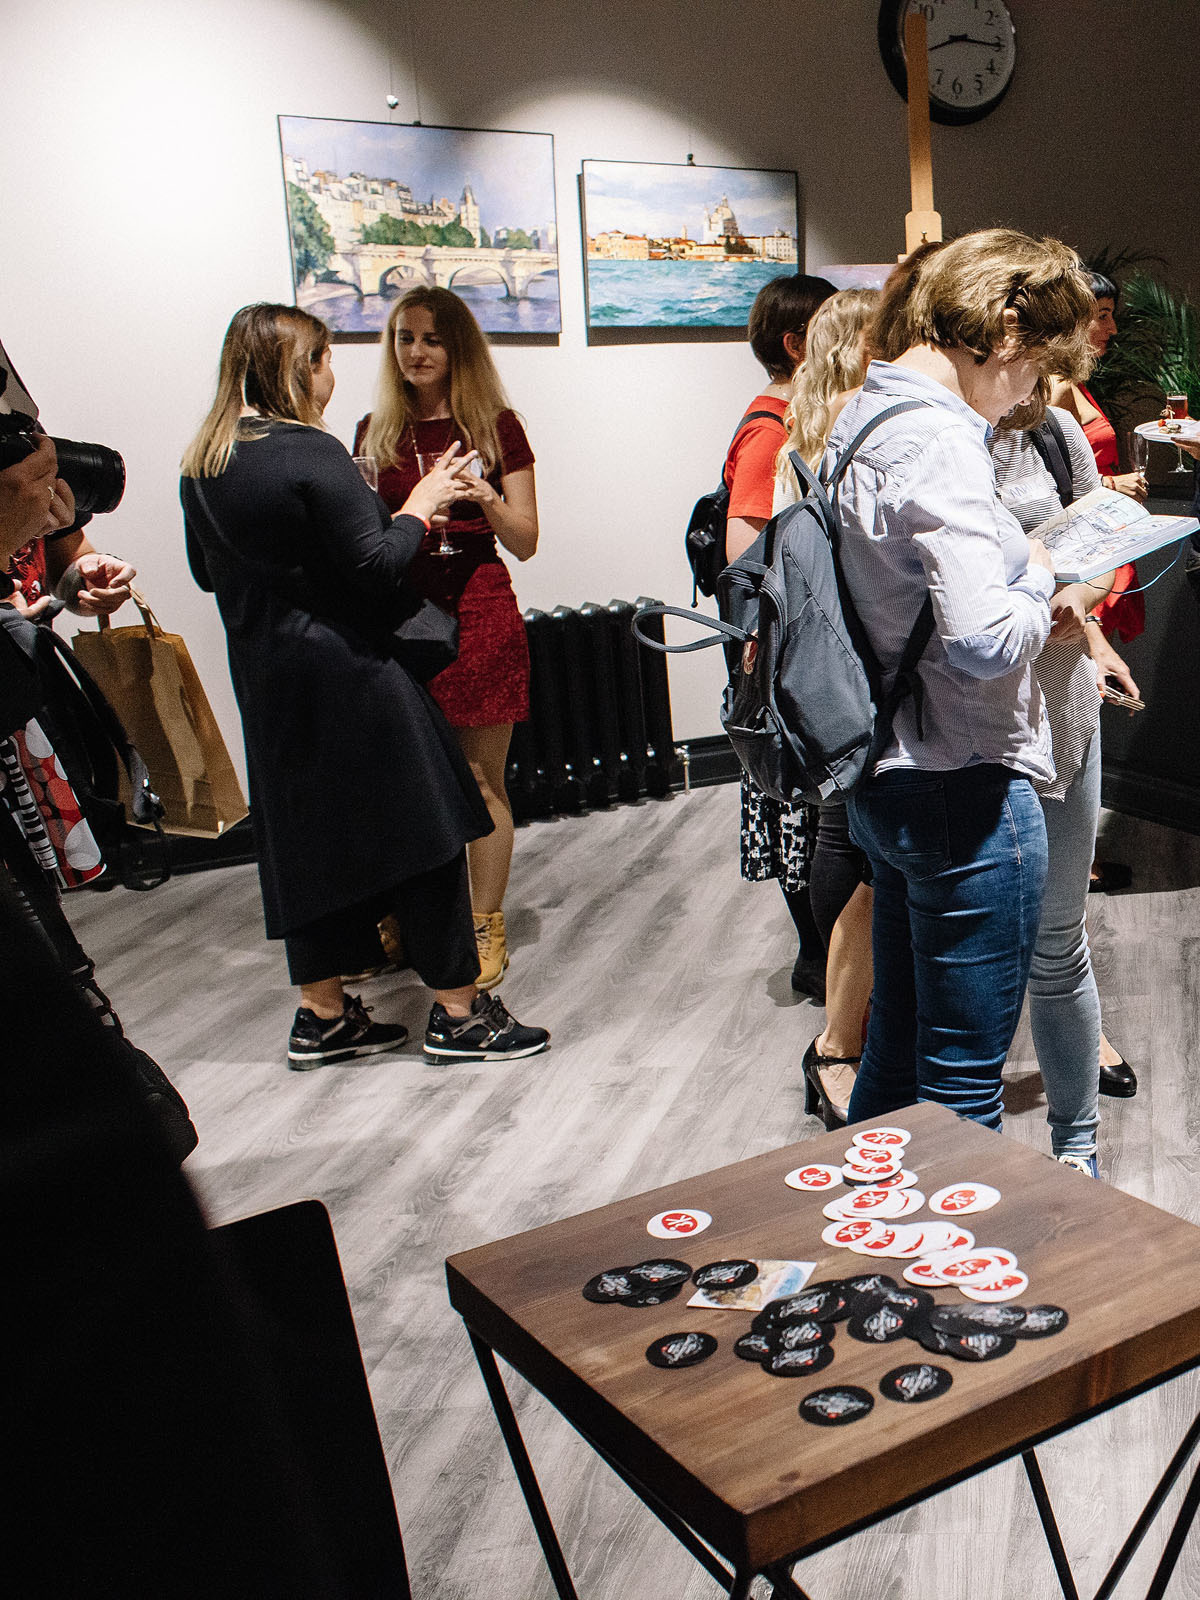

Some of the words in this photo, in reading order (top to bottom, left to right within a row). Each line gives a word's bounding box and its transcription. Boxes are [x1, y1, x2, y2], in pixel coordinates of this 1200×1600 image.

[984, 10, 995, 26] 2
[993, 35, 1003, 53] 3
[986, 58, 996, 75] 4
[935, 68, 945, 86] 7
[952, 76, 963, 96] 6
[974, 73, 983, 94] 5
